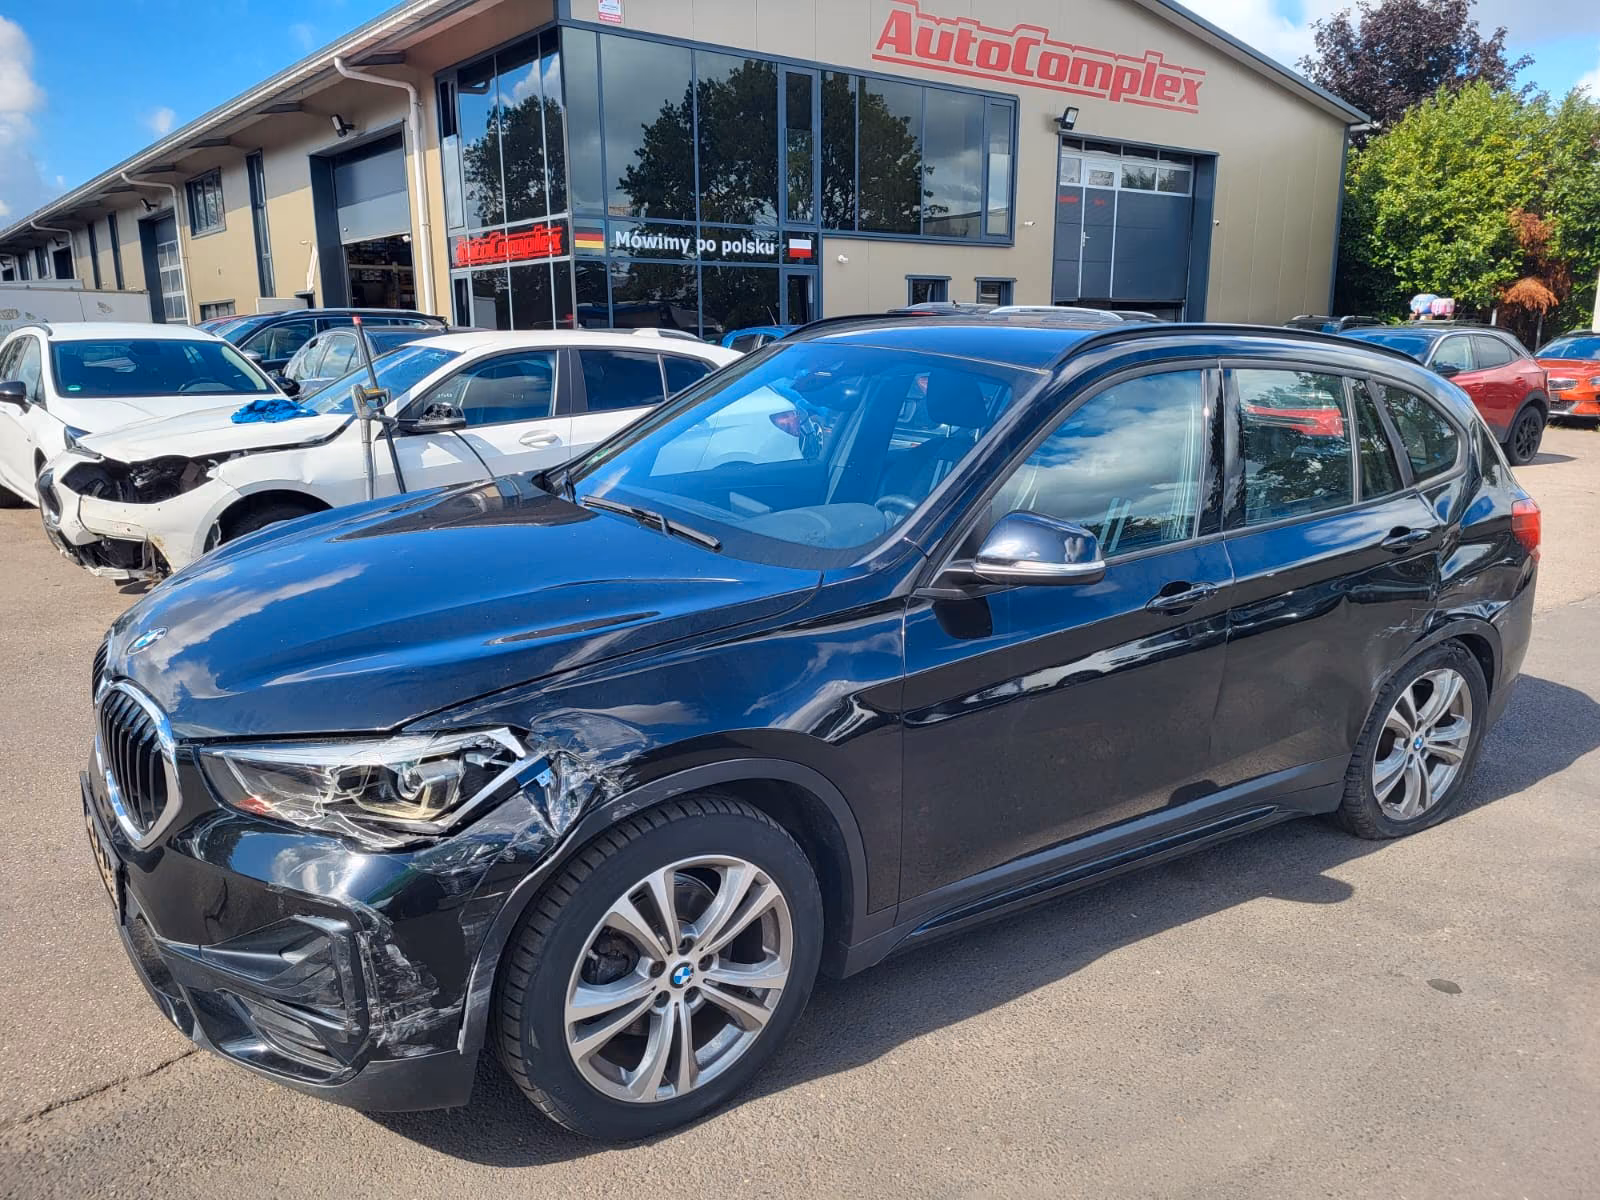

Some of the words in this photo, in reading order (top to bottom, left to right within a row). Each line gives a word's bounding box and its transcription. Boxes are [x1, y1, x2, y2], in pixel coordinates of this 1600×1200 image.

[875, 9, 1204, 106] AutoComplex
[615, 230, 690, 255] Mówimy
[696, 238, 717, 255] po
[722, 237, 775, 256] polsku
